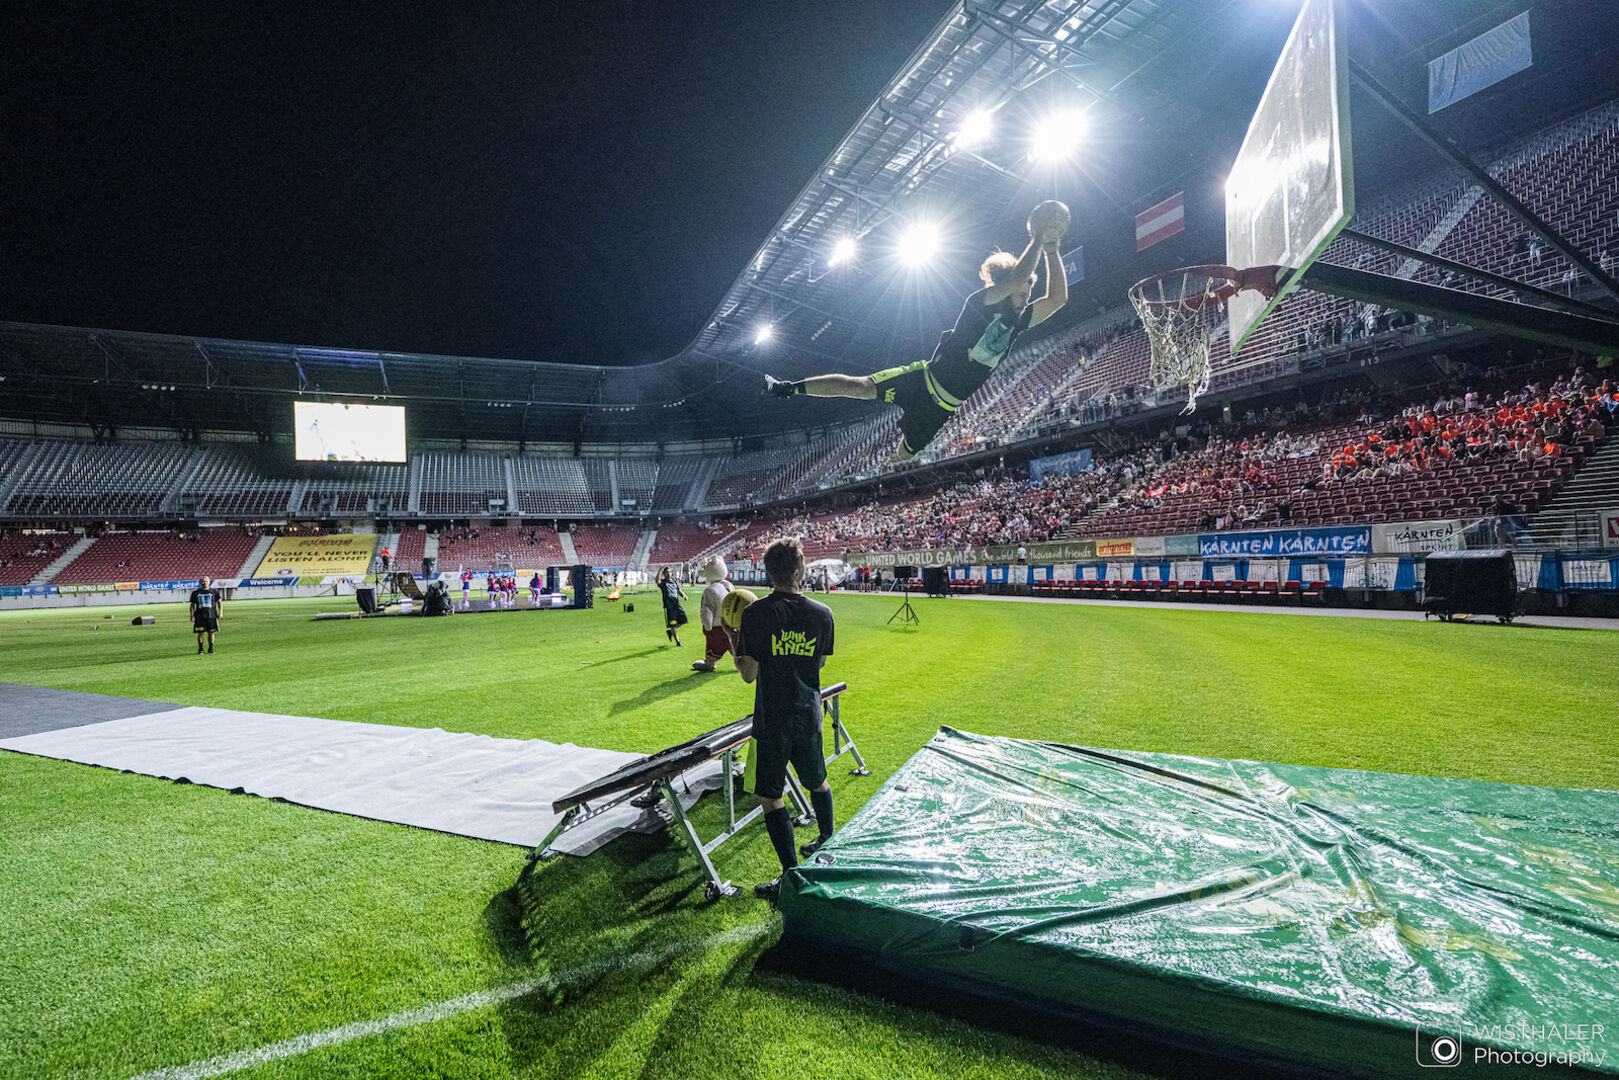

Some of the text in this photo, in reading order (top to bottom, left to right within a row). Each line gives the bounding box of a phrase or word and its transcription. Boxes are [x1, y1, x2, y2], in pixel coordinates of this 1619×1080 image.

[866, 554, 895, 566] UNITED
[897, 552, 933, 565] WORLD
[936, 549, 977, 564] GAMES
[1065, 546, 1092, 559] friends
